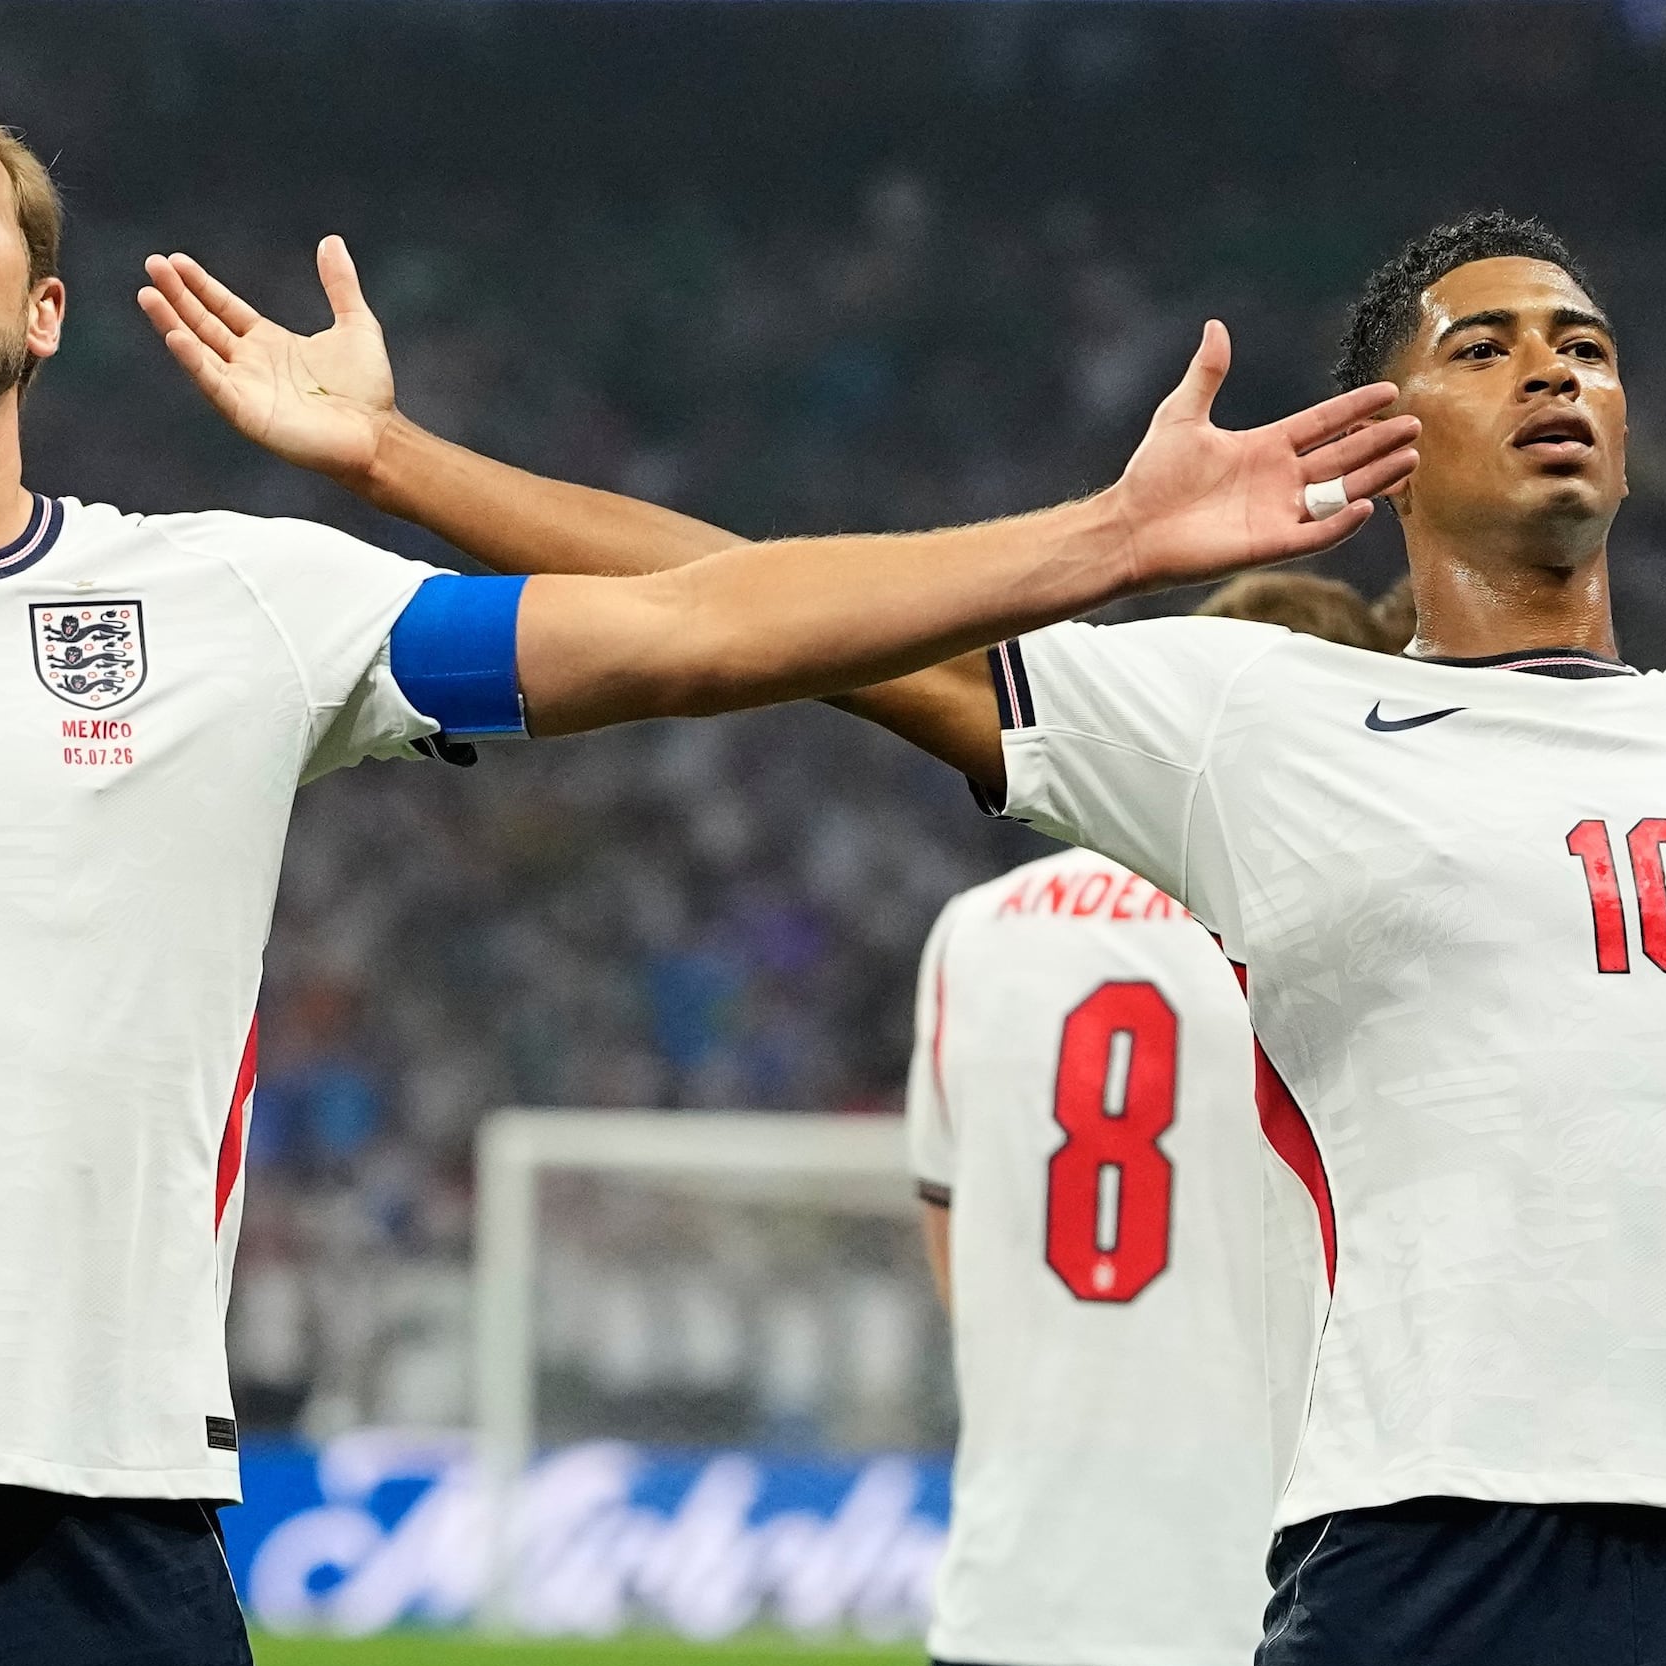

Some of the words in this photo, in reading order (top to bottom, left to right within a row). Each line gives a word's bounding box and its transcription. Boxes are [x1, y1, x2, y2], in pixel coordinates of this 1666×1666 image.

[62, 720, 132, 739] MEXICO
[64, 747, 133, 765] 05.07.26
[996, 870, 1192, 920] ANDER
[1045, 980, 1179, 1303] 8
